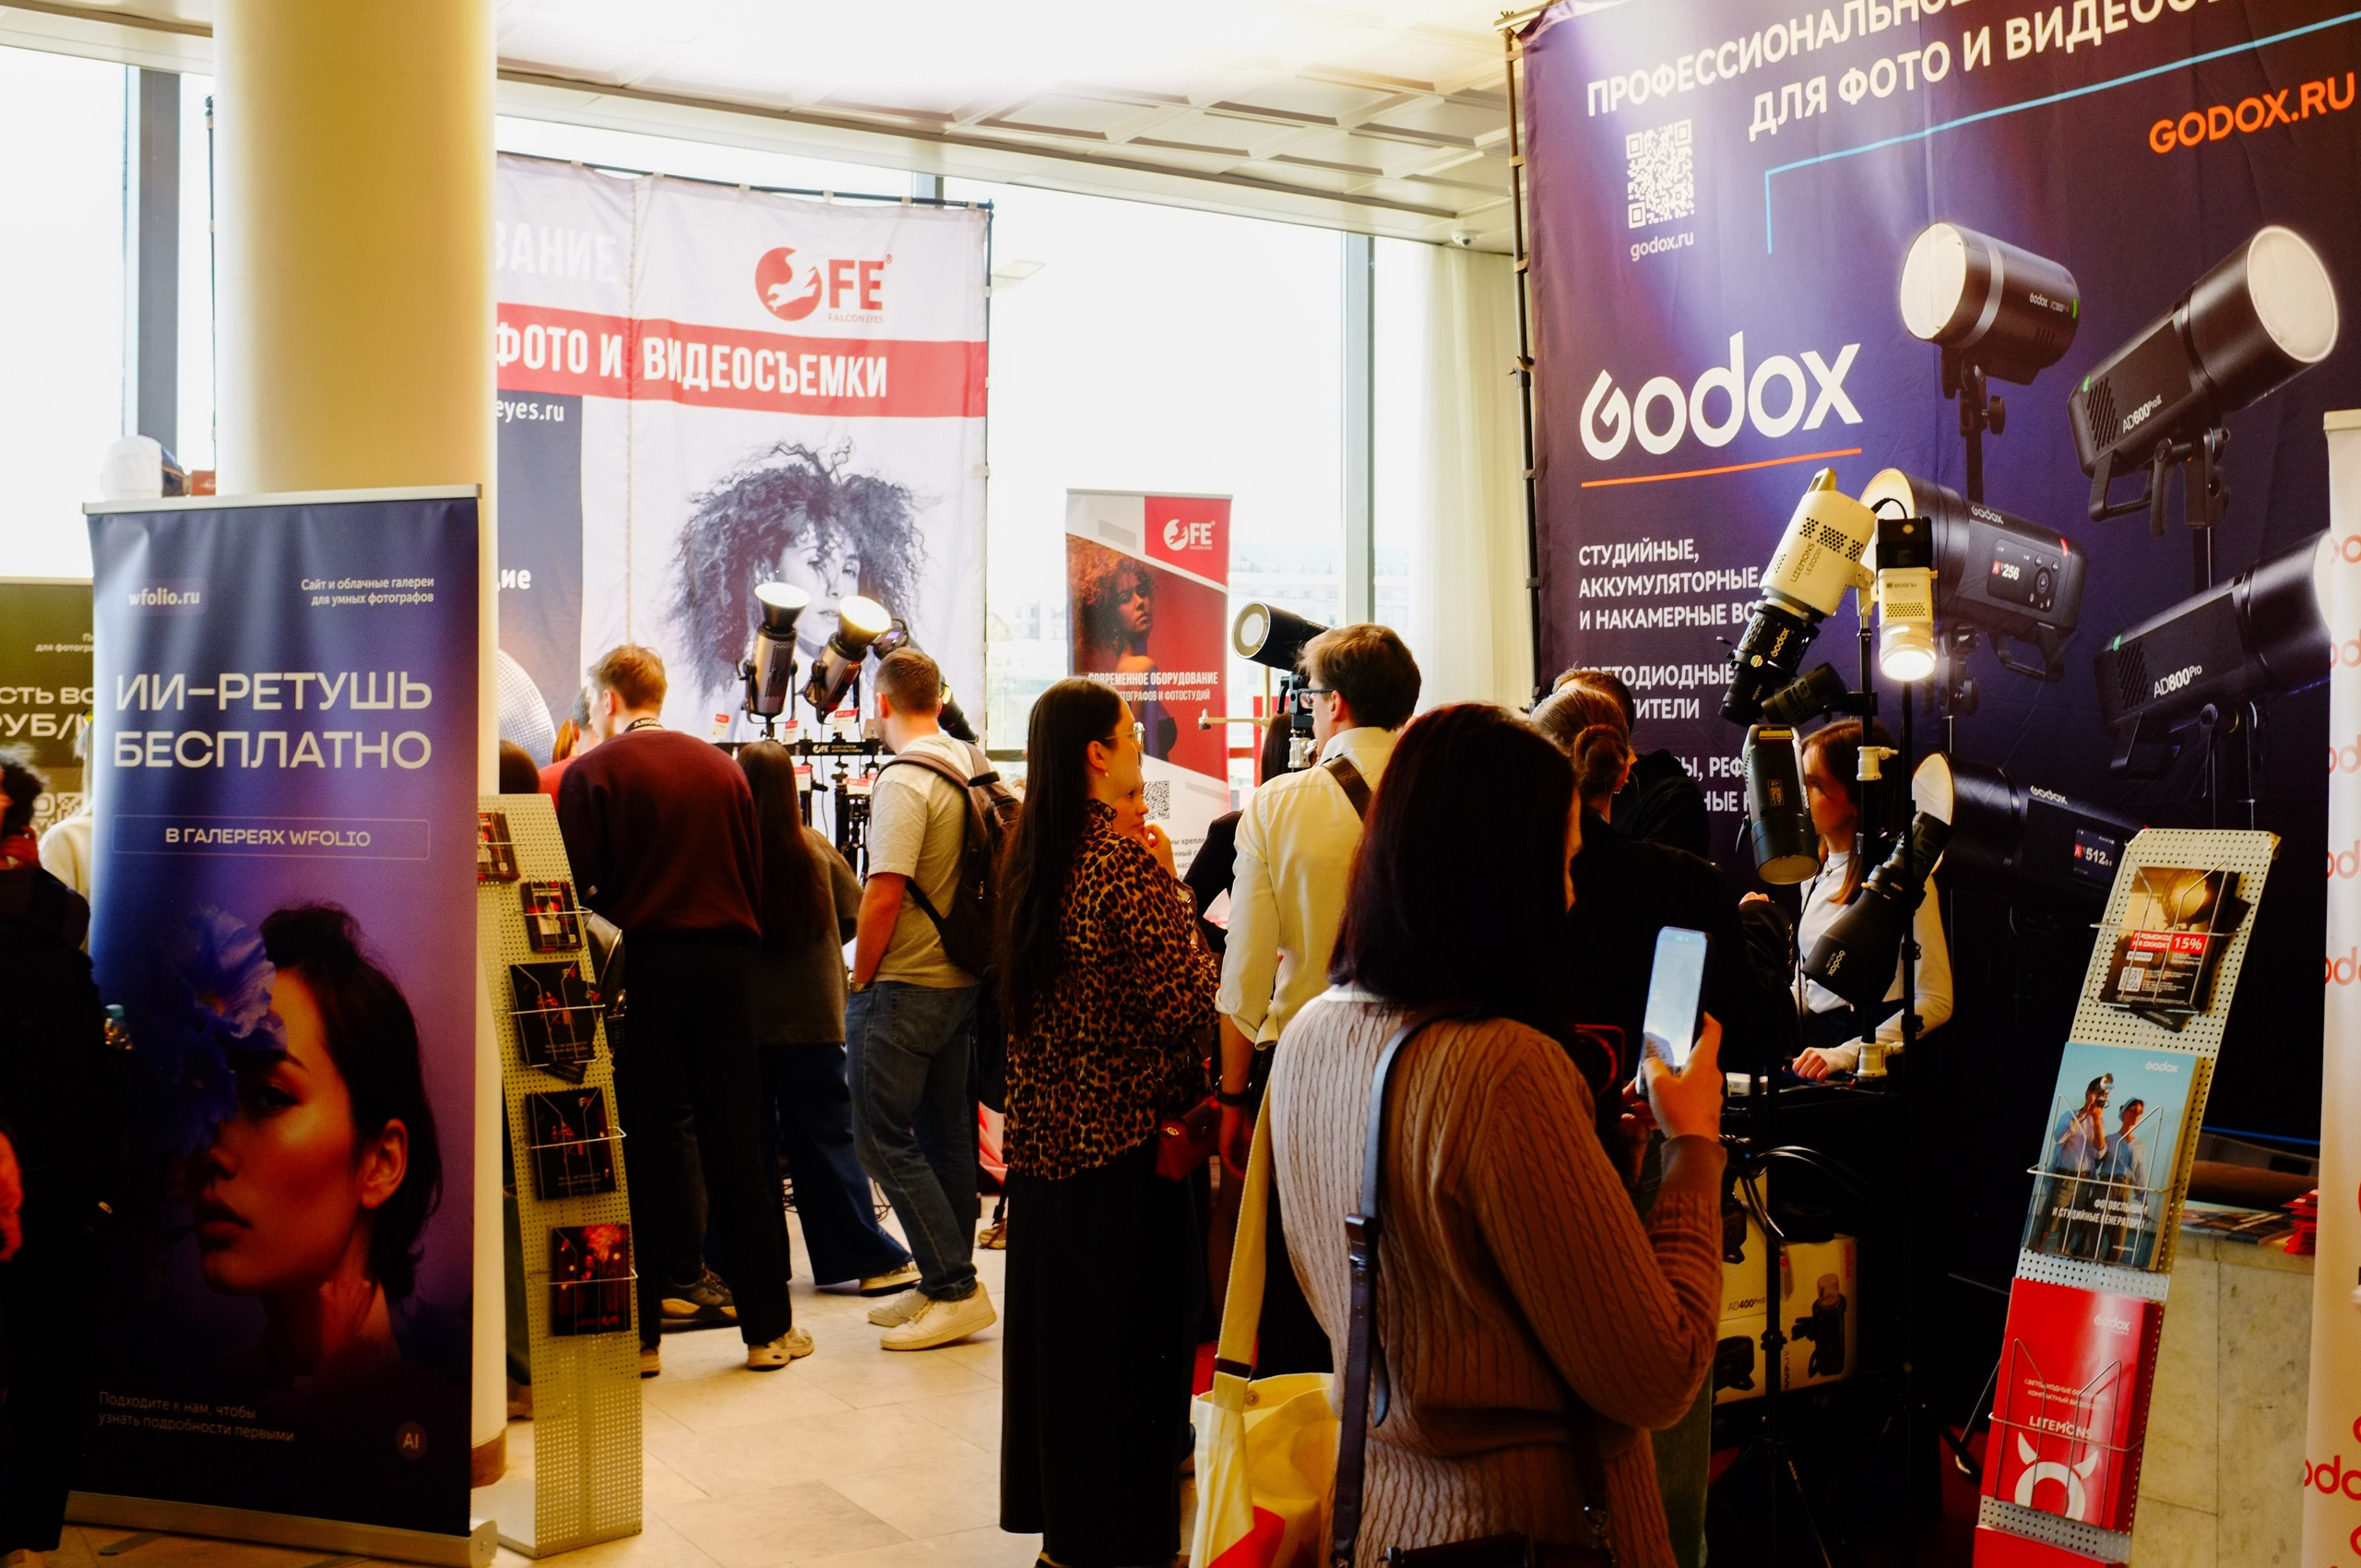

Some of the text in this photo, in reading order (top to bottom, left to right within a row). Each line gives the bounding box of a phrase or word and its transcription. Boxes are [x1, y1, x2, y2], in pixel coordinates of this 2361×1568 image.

[1587, 0, 1973, 117] ПРОФЕССИОНАЛЬН
[1749, 0, 2213, 141] ДЛЯ ФОТО И ВИДЕО
[2150, 72, 2355, 154] GODOX.RU
[1630, 231, 1695, 262] godox.ru
[828, 259, 884, 310] FE
[496, 322, 887, 398] ФОТО И ВИДЕОСЪЕМКИ
[1579, 330, 1863, 460] Godox
[496, 399, 564, 423] eyes.ru
[1972, 505, 2004, 525] Godox
[1190, 522, 1213, 545] FE
[1579, 537, 1700, 568] СТУДИЙНЫЕ,
[301, 576, 434, 591] Сайт и облачные галереи
[497, 568, 531, 591] ие
[128, 588, 201, 606] wfolio.ru
[312, 591, 434, 607] для умных фотографов
[1579, 610, 1591, 631] И
[1596, 603, 1727, 630] НАКАМЕРНЫЕ
[1771, 627, 1790, 658] Godox
[1151, 671, 1218, 686] ОБОРУДОВАНИЕ
[1581, 664, 1735, 690] ТОДИОДНЫЕ
[2153, 664, 2202, 699] AD800Pro
[1158, 691, 1163, 701] И
[1165, 689, 1210, 702] ФОТОСТУДИЙ
[0, 713, 85, 740] УБ/
[113, 731, 433, 770] БЕСПЛАТНО
[2030, 785, 2069, 804] Godox
[166, 829, 371, 848] В ГАЛЕРЕЯХ WFOLIO
[2143, 941, 2169, 949] СКИДК
[2175, 937, 2203, 951] 15%
[1827, 949, 1846, 977] Godox
[2145, 1061, 2179, 1074] Godox
[2094, 1314, 2130, 1331] Godox
[99, 1391, 256, 1420] Подходите к нам, чтобы
[98, 1412, 295, 1444] узнать подробности первыми
[2029, 1415, 2093, 1439] LITEMONS
